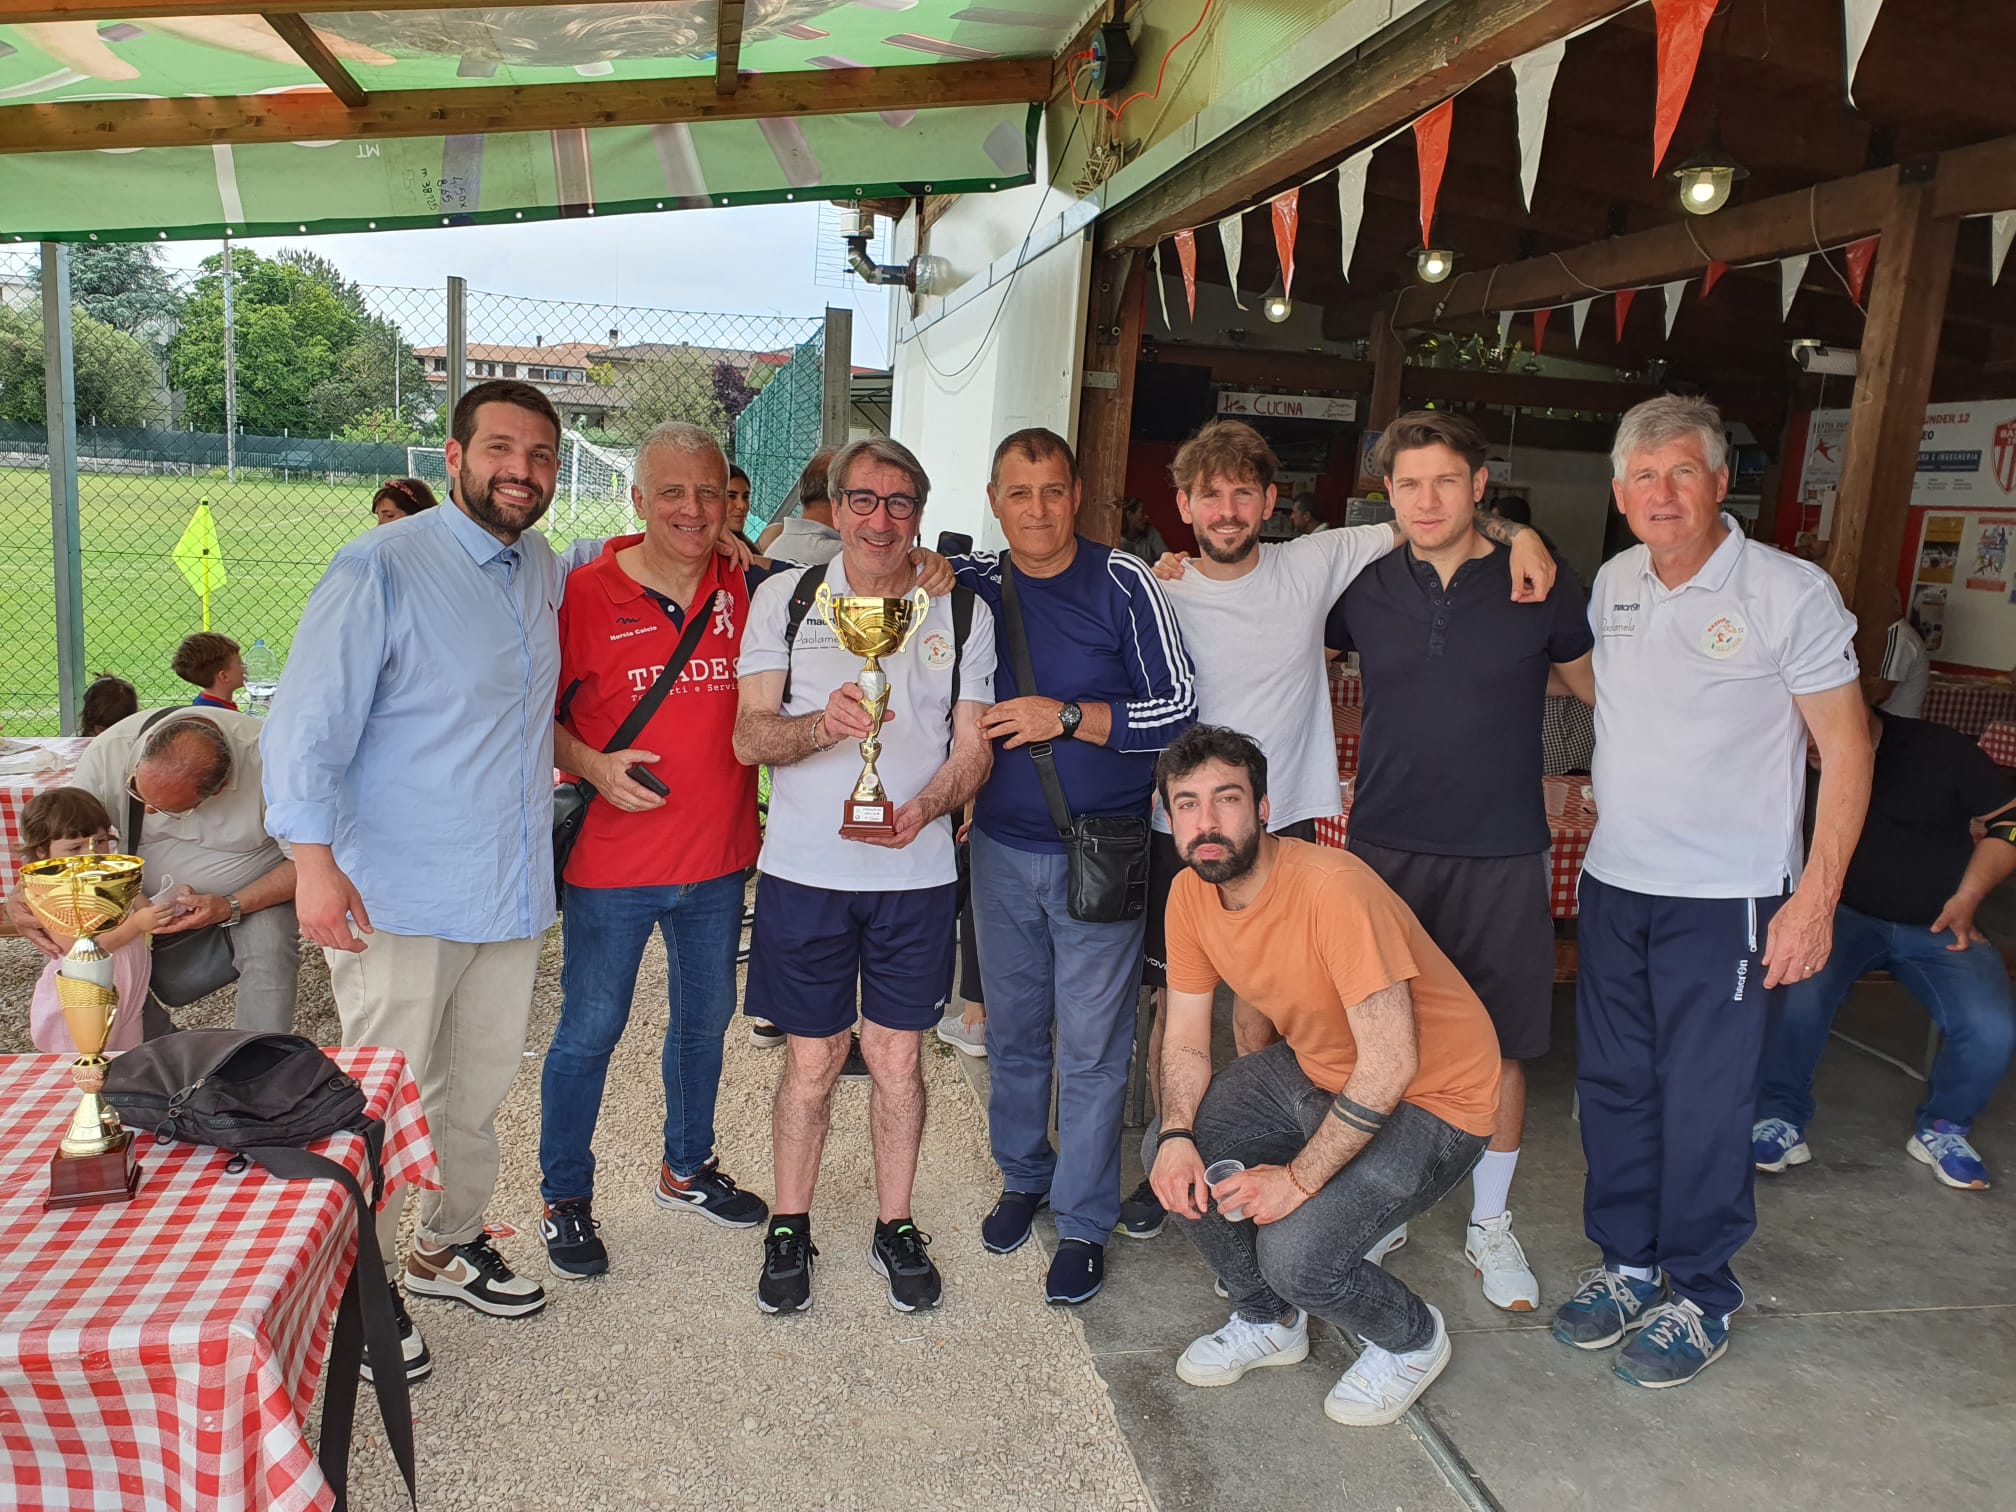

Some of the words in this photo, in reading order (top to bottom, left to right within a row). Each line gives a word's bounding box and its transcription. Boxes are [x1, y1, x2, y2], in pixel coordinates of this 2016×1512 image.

[357, 144, 380, 158] MT
[1958, 413, 1970, 424] 12
[635, 625, 658, 635] Calcio
[707, 683, 737, 692] Servi
